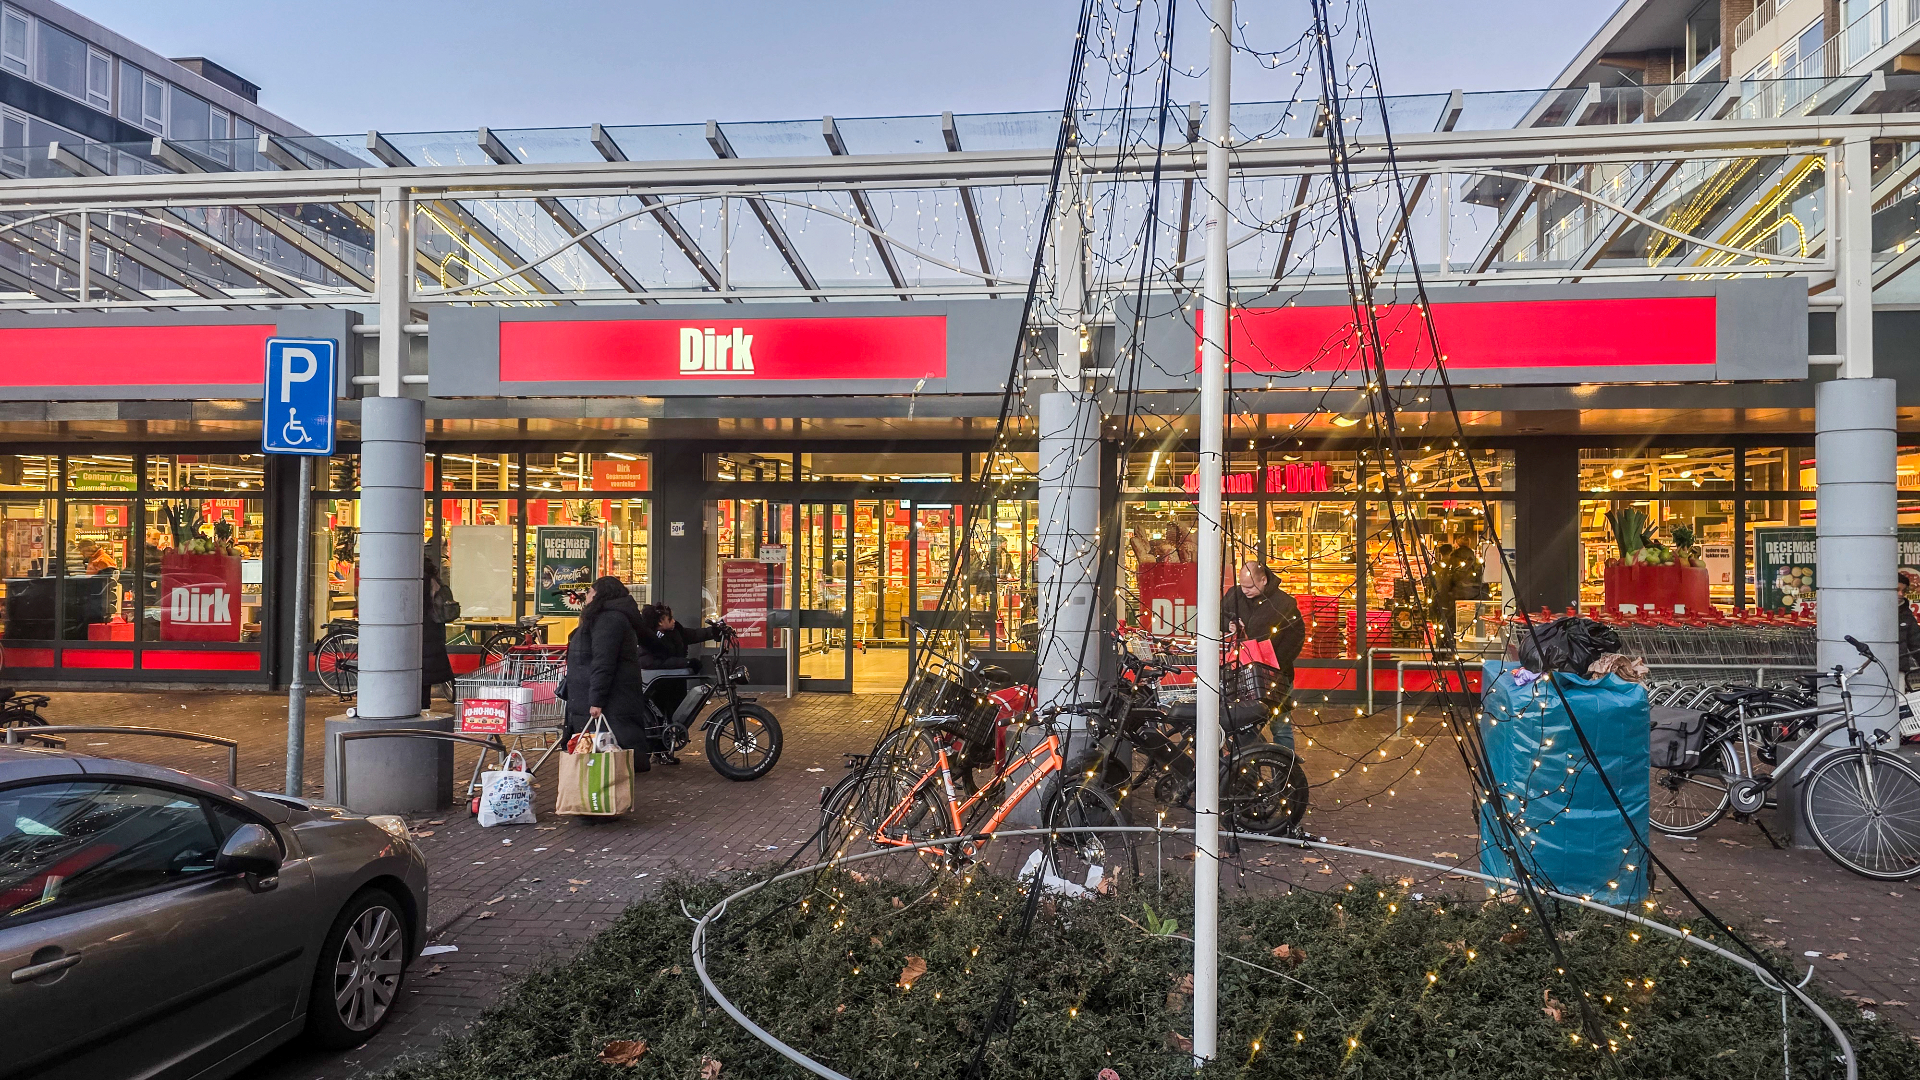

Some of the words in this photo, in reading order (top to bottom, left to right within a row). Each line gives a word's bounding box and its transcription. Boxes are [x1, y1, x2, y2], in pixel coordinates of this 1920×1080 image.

[680, 327, 754, 374] Dirk
[281, 347, 317, 402] P
[617, 464, 630, 472] Dirk
[83, 473, 112, 481] Contant
[1285, 461, 1327, 493] Dirk
[545, 538, 590, 549] DECEMBER
[1766, 541, 1817, 553] DECEMBE
[546, 549, 565, 558] MET
[566, 549, 587, 558] DIRK
[1769, 553, 1792, 565] MET
[550, 568, 582, 585] Viennetta
[171, 587, 231, 625] Dirk
[1152, 598, 1197, 636] Dir
[500, 792, 527, 800] ACTION
